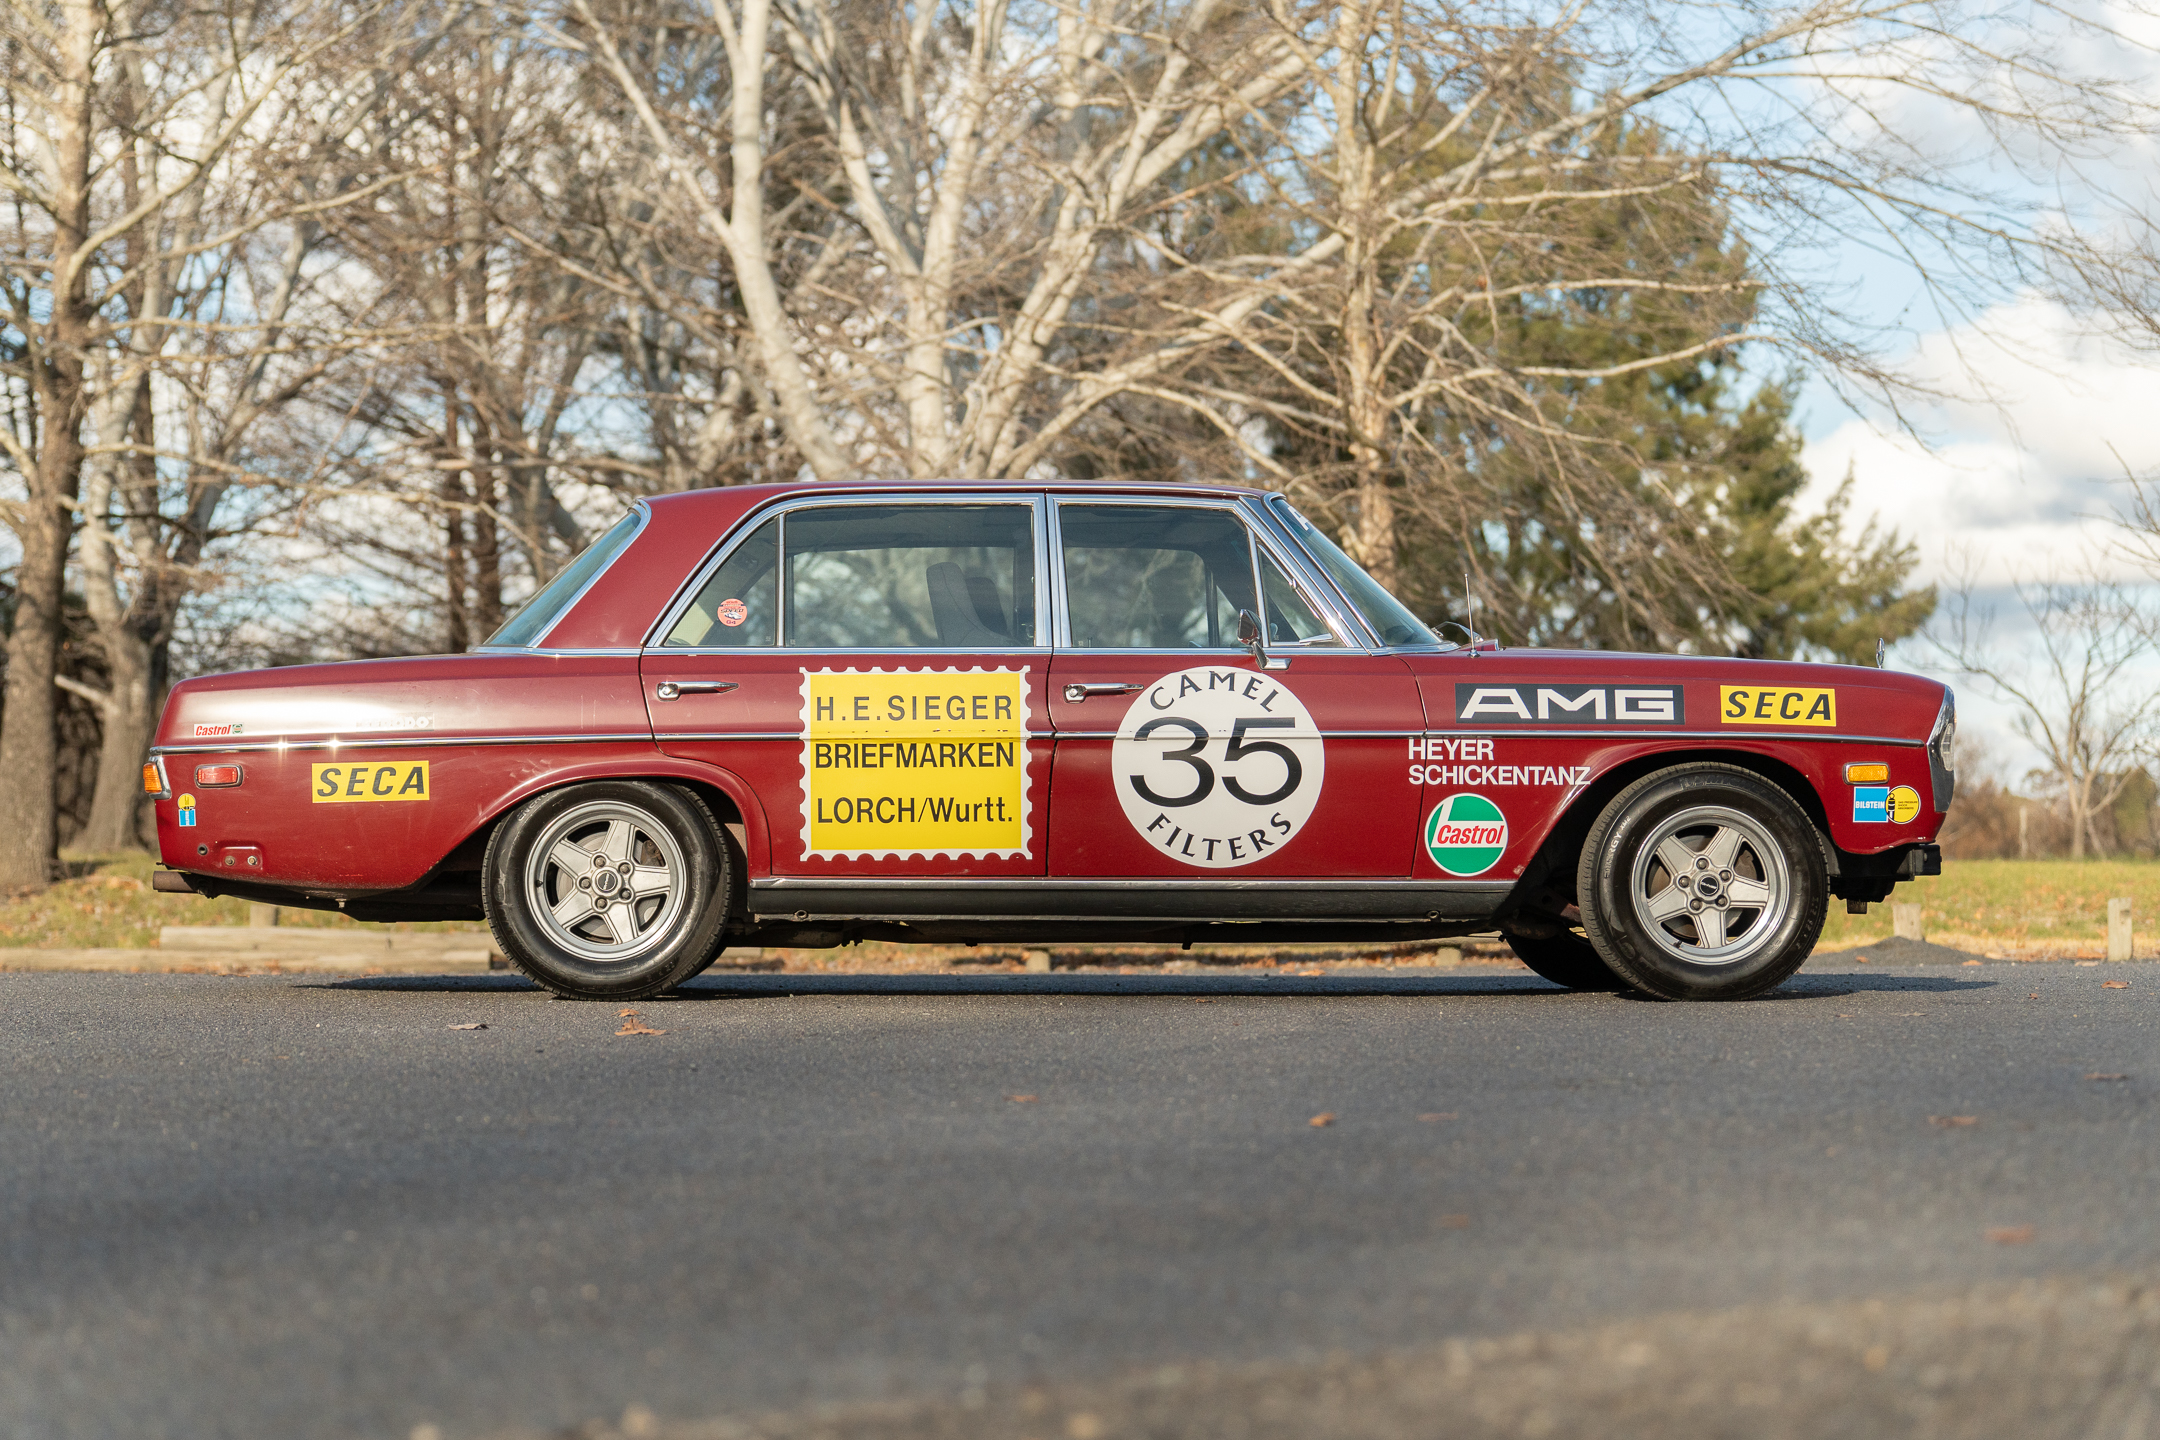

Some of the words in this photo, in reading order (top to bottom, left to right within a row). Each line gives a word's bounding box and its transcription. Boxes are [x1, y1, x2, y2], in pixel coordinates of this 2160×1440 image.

[1150, 670, 1279, 712] CAMEL
[1460, 688, 1675, 720] AMG
[1725, 690, 1832, 721] SECA
[196, 725, 231, 736] Castrol
[815, 742, 1014, 769] BRIEFMARKEN
[1129, 717, 1303, 807] 35
[1408, 738, 1494, 761] HEYER
[317, 766, 425, 797] SECA
[1408, 765, 1591, 785] SCHICKENTANZ
[818, 796, 1012, 824] LORCH/Wurtt.
[1855, 801, 1885, 809] BILSTEIN
[1146, 812, 1292, 860] FILTERS
[1437, 825, 1504, 844] Castrol
